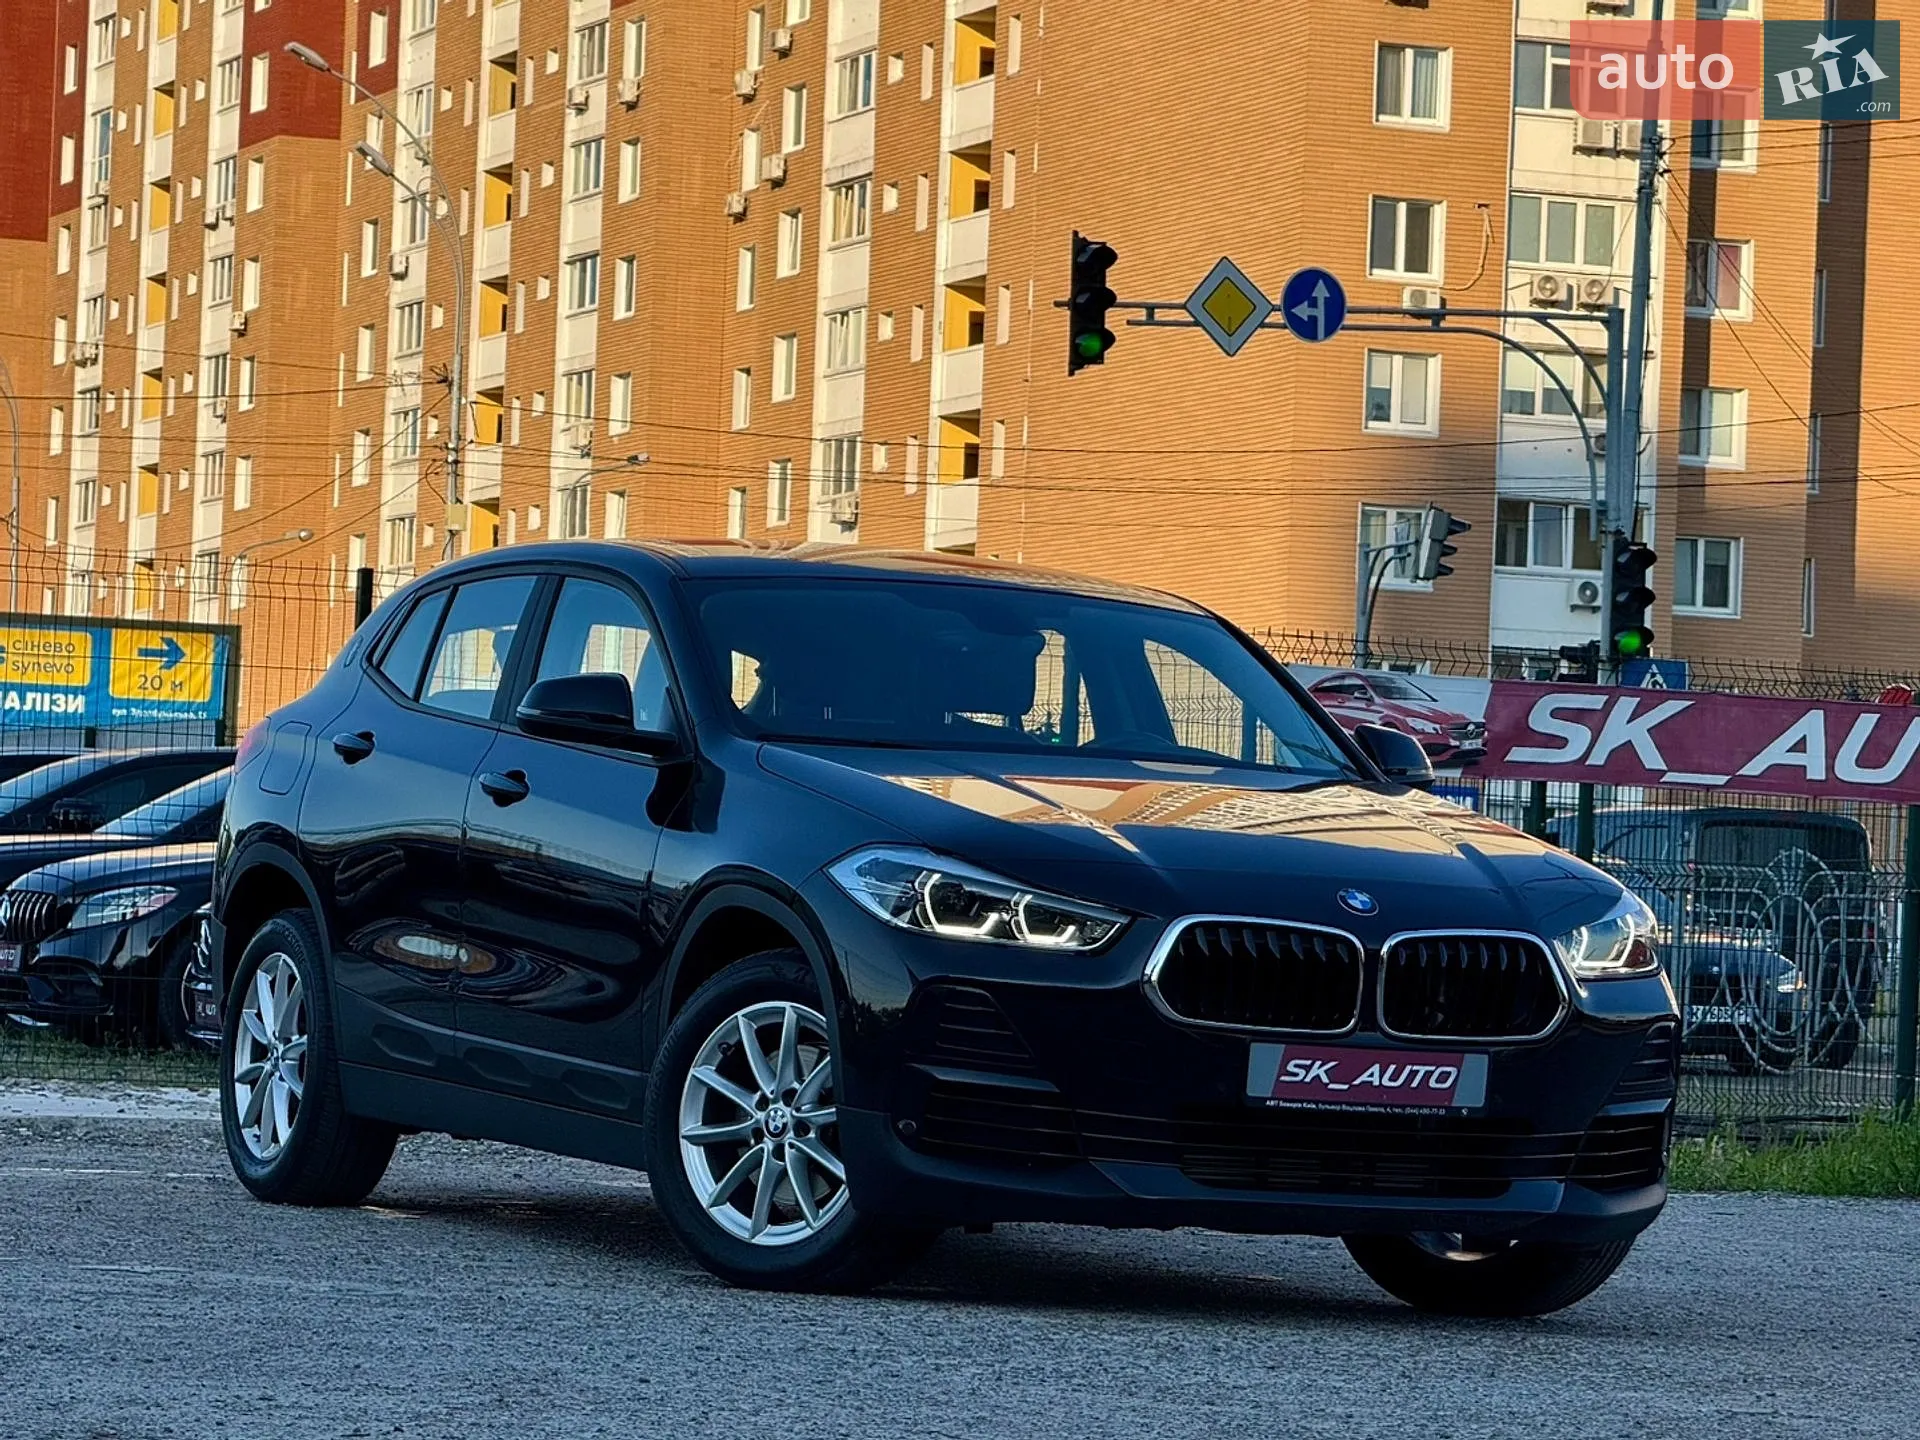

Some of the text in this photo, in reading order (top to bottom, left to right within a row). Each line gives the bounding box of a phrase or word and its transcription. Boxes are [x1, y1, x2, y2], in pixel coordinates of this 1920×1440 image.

[12, 639, 75, 654] сінево
[12, 660, 75, 675] synevo
[137, 674, 163, 691] 20
[0, 690, 85, 713] АЛІЗИ
[1280, 1060, 1458, 1090] SK_AUTO
